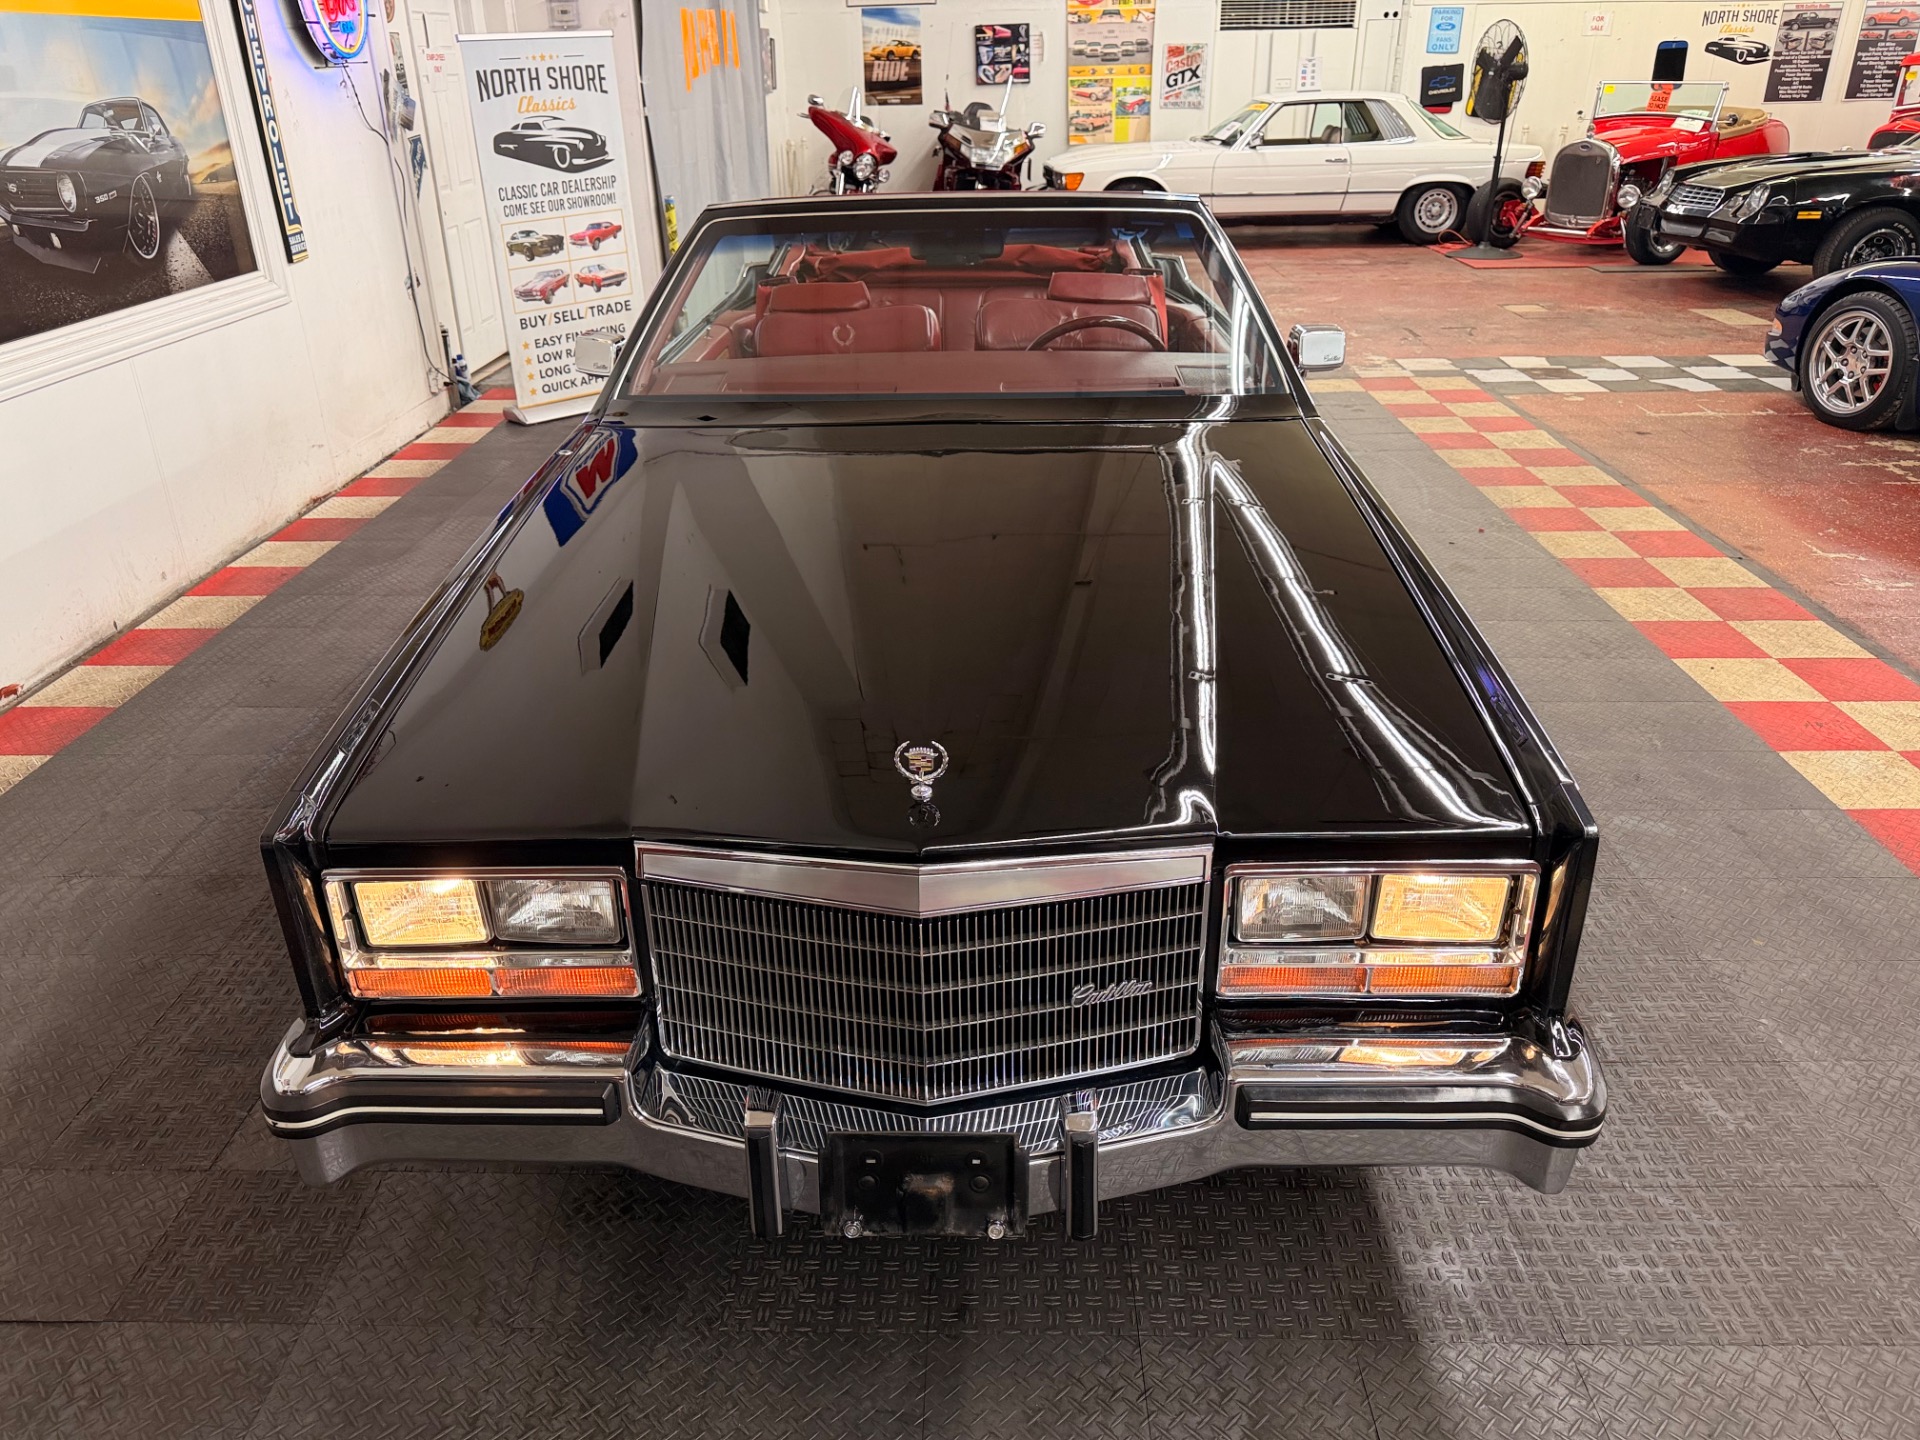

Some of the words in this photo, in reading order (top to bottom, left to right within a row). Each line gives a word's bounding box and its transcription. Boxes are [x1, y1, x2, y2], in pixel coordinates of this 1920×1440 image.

[1702, 10, 1738, 27] NORTH
[1743, 9, 1780, 25] SHORE
[1719, 24, 1755, 34] Classics
[872, 60, 910, 82] RIDE
[1166, 64, 1201, 88] GTX
[476, 68, 542, 102] NORTH
[546, 64, 608, 94] SHORE
[518, 96, 576, 114] Classics
[498, 184, 538, 202] CLASSIC
[540, 182, 560, 196] CAR
[562, 175, 616, 194] DEALERSHIP
[503, 202, 528, 218] COME
[530, 201, 546, 214] SEE
[548, 198, 566, 212] OUR
[567, 192, 616, 210] SHOWROOM!
[534, 335, 562, 348] EASY
[566, 323, 626, 343] FINCING
[536, 350, 562, 364] LOW
[539, 364, 572, 379] LONG
[542, 380, 578, 394] QUICK
[1072, 979, 1153, 1008] Cadillac
